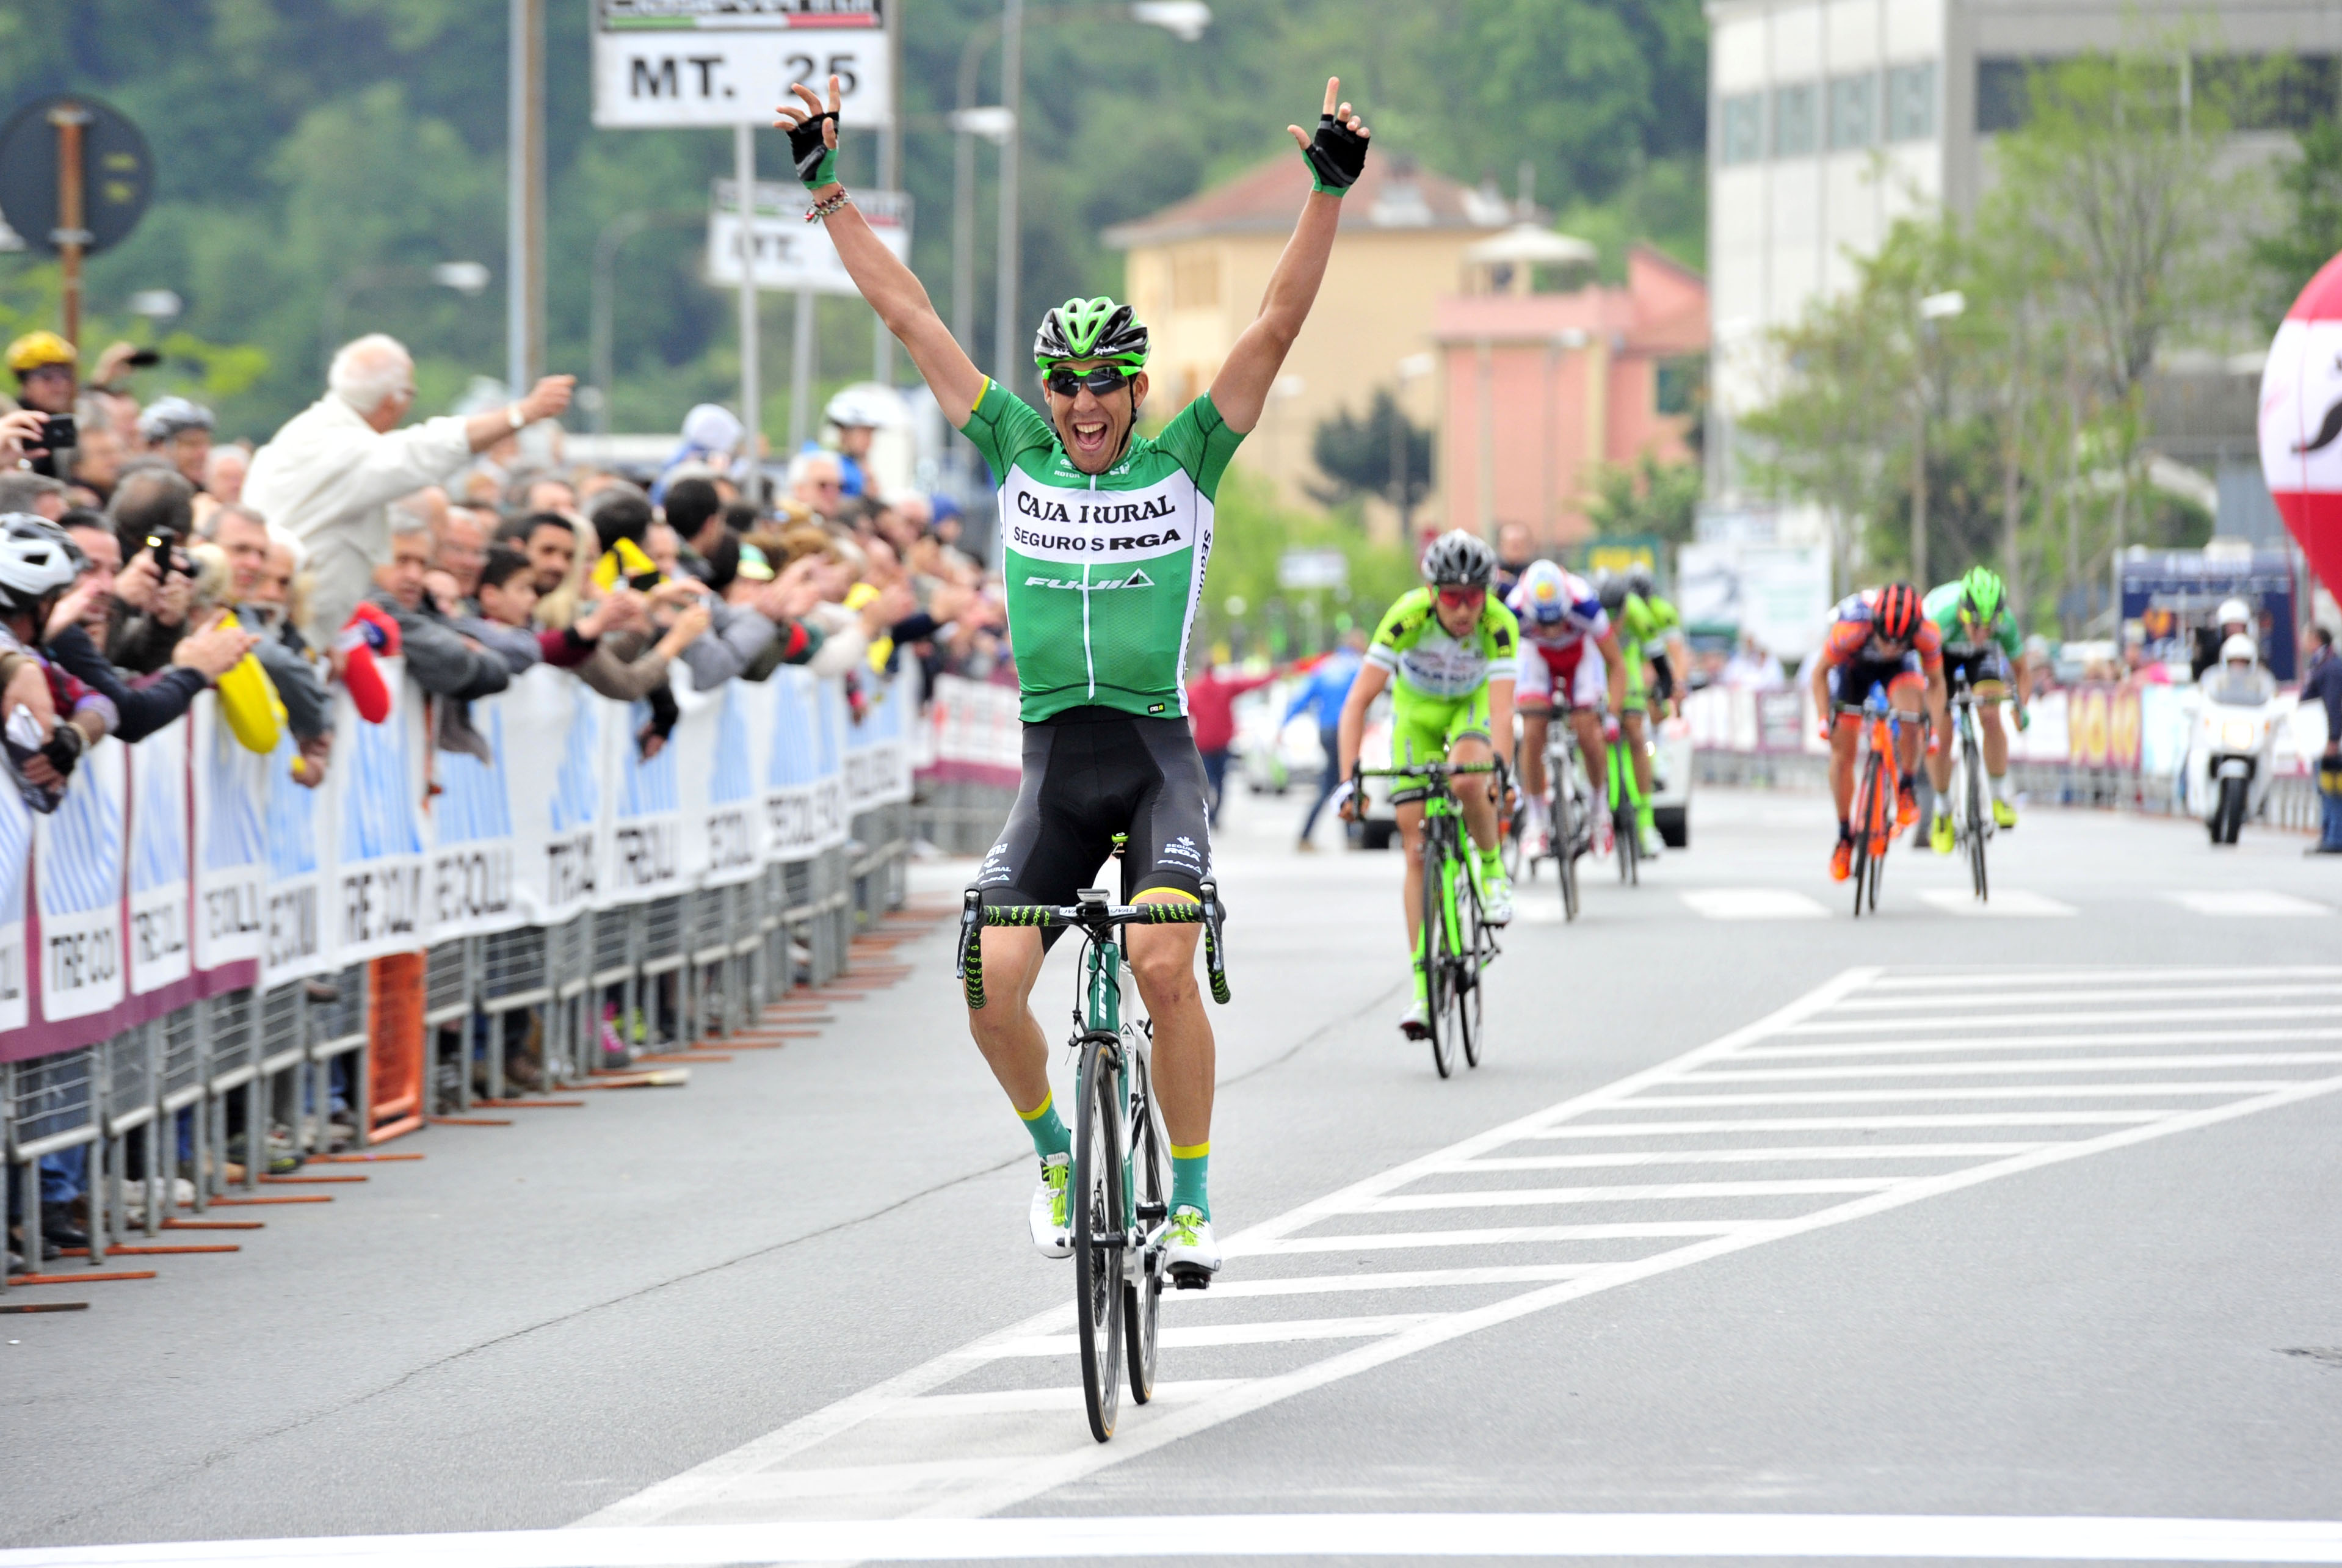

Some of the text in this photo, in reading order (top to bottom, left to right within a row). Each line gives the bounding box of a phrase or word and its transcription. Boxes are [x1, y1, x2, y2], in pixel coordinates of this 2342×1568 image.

[631, 55, 858, 98] MT. 25
[1018, 490, 1175, 524] CAJA RURAL
[1013, 526, 1181, 551] SEGUROS RGA
[1024, 576, 1125, 590] FUJI
[1164, 848, 1200, 862] RGA
